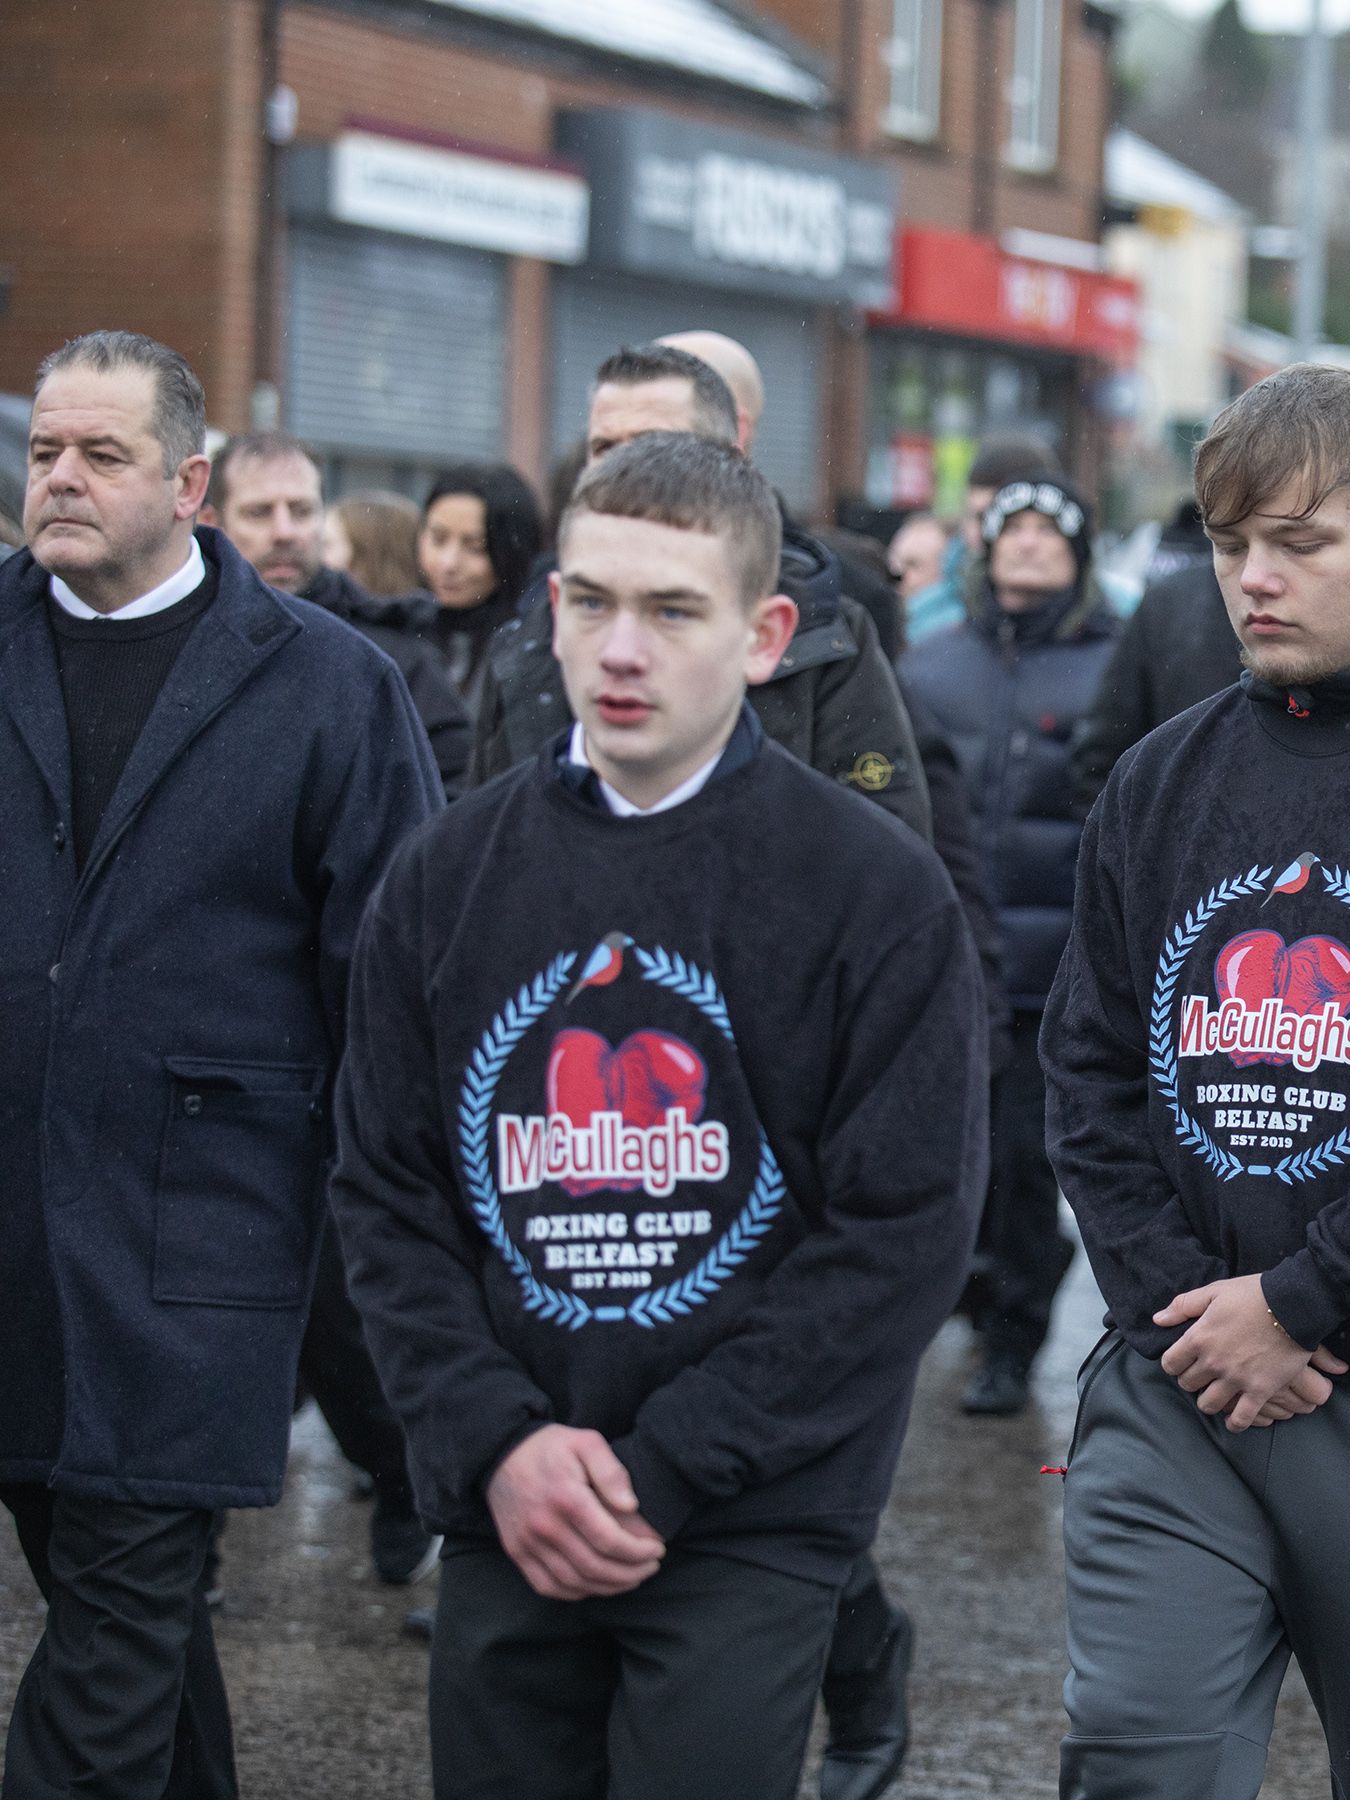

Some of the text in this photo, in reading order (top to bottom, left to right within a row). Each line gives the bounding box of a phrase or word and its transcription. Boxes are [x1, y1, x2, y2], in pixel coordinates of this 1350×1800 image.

[1197, 1084, 1347, 1112] BOXING CLUB
[1214, 1109, 1313, 1133] BELFAST
[497, 1106, 730, 1198] MCullaghs
[1230, 1134, 1293, 1149] EST 2019
[525, 1209, 712, 1242] OXING CLUB
[545, 1241, 678, 1270] BELFAST
[571, 1271, 606, 1290] EST
